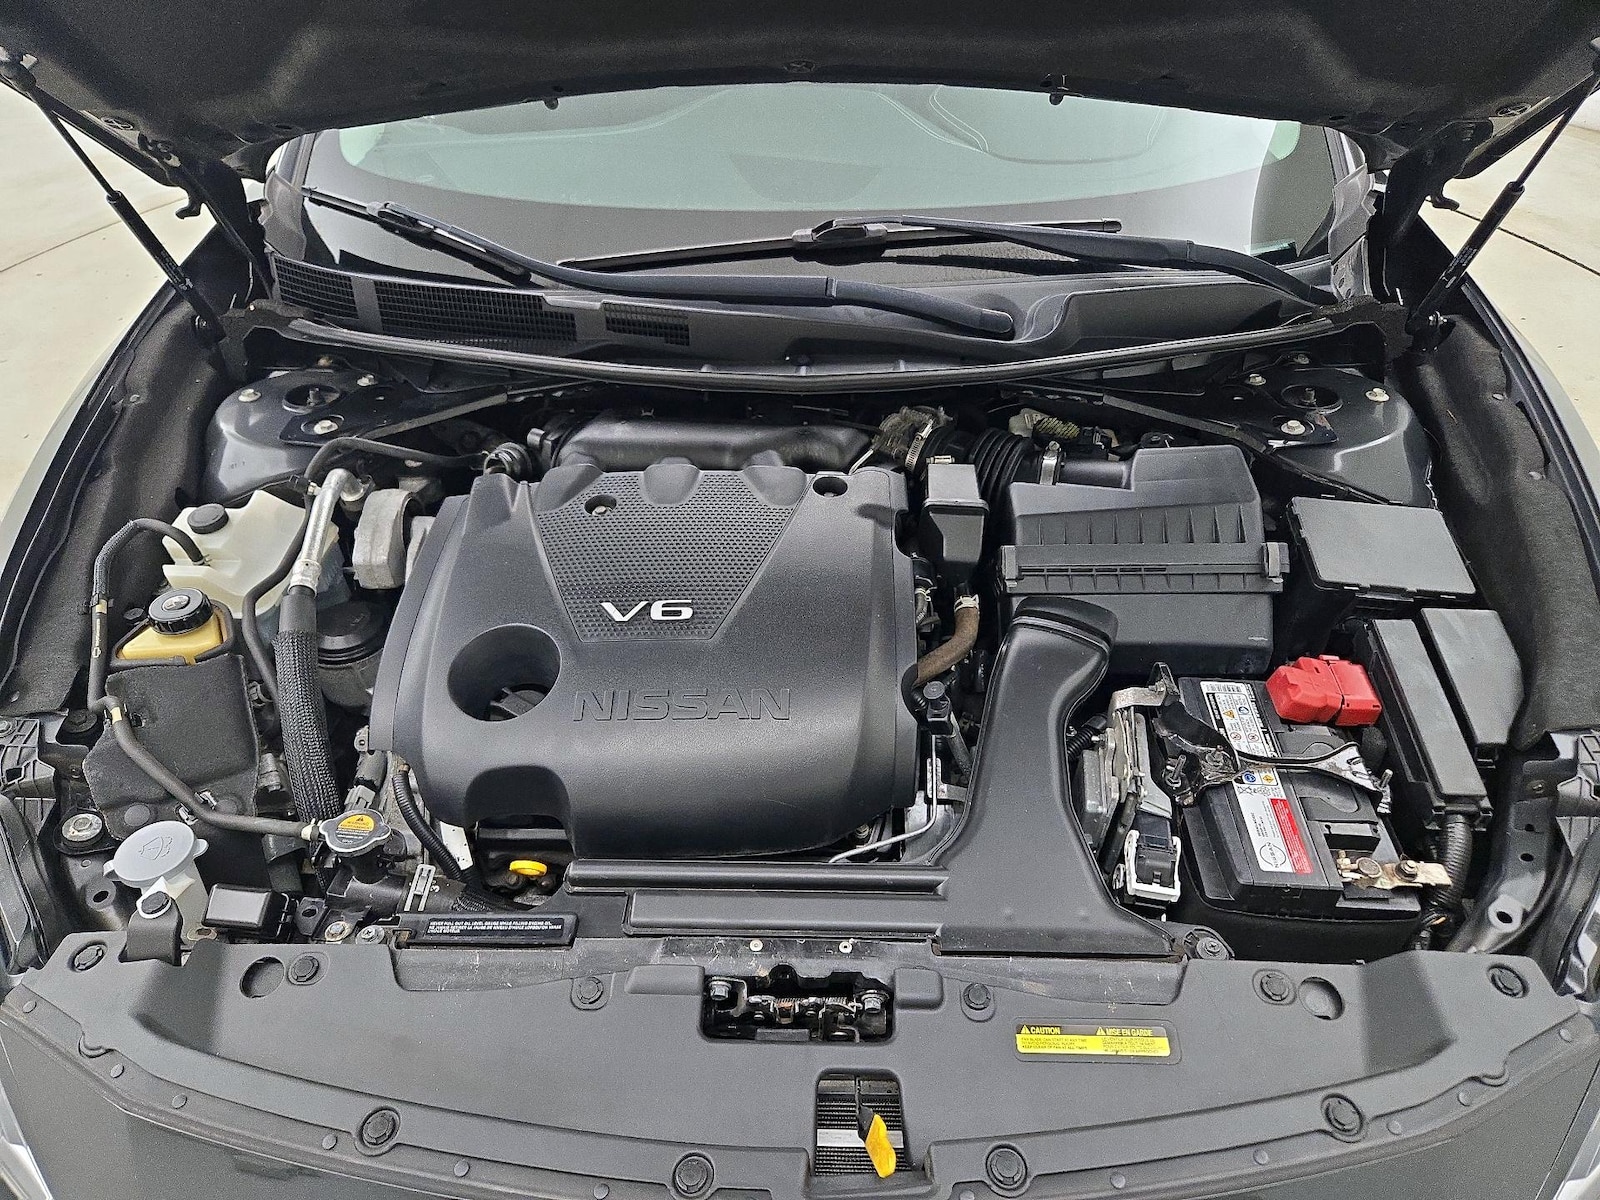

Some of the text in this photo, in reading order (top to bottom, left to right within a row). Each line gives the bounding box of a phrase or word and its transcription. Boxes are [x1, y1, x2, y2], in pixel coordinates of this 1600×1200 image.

[601, 600, 693, 622] V6
[573, 687, 790, 721] NISSAN
[1030, 1026, 1061, 1035] CAUTION
[1122, 1028, 1131, 1036] EN
